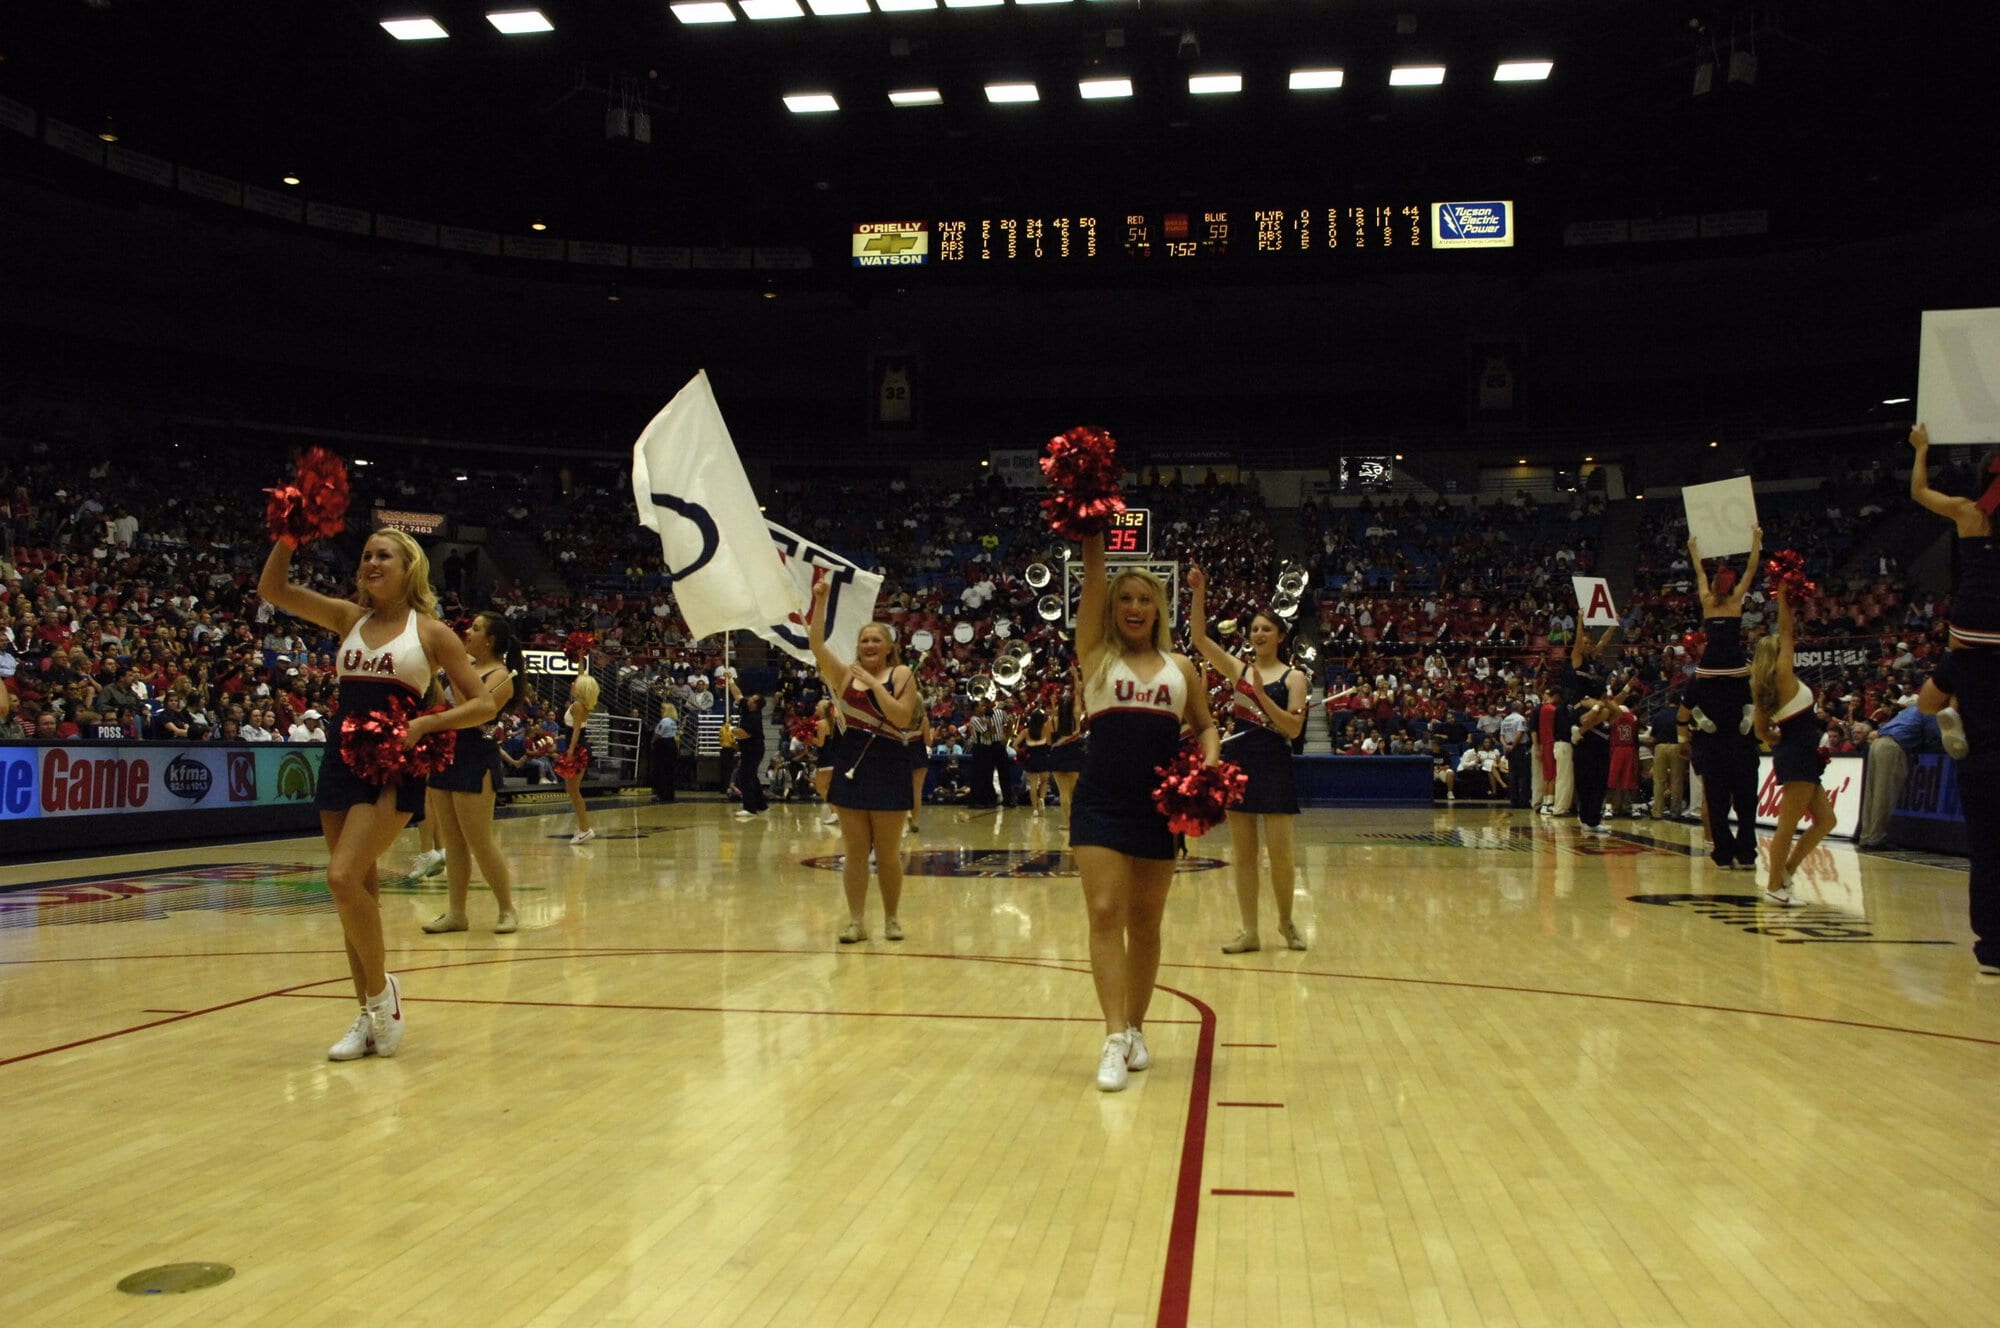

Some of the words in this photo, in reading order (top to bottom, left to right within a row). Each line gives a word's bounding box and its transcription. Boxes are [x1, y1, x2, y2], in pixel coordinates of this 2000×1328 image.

[1204, 213, 1228, 222] BLUE
[1255, 211, 1284, 221] PLYR
[1301, 210, 1310, 220] 0
[1328, 209, 1337, 219] 2
[1349, 207, 1365, 217] 12
[1376, 207, 1392, 217] 14
[1402, 205, 1419, 216] 44
[1455, 206, 1492, 217] Tucson
[938, 221, 966, 232] PLYR
[983, 220, 991, 230] 5
[1001, 219, 1017, 229] 20
[1027, 219, 1043, 229] 34
[1053, 218, 1070, 228] 42
[1080, 217, 1096, 227] 50
[1127, 215, 1144, 225] RED
[1260, 221, 1281, 231] PTS
[1295, 220, 1310, 230] 17
[1459, 215, 1499, 225] Electric
[859, 222, 922, 233] O'RIELLY
[942, 231, 963, 241] PTS
[1088, 227, 1096, 237] 4
[1128, 227, 1147, 242] 54
[1209, 224, 1228, 239] 59
[1463, 224, 1500, 234] Power
[1259, 231, 1282, 241] RBS
[1328, 229, 1337, 239] 0
[941, 241, 964, 251] RBS
[1166, 242, 1198, 257] 7:52
[1259, 240, 1282, 251] FLS
[1301, 240, 1310, 250] 5
[1328, 239, 1337, 249] 0
[1034, 248, 1043, 258] 0
[859, 255, 922, 266] WATSON
[886, 386, 905, 400] 32
[1113, 513, 1144, 526] 7:52
[1108, 530, 1137, 551] 35
[1586, 583, 1616, 620] A
[344, 649, 362, 671] U
[362, 656, 378, 671] of
[377, 651, 396, 674] A
[1793, 651, 1833, 667] USCLE
[1115, 680, 1134, 702] U
[1135, 690, 1153, 703] of
[1154, 684, 1172, 706] A
[98, 726, 125, 739] POSS.
[1617, 724, 1632, 741] 13
[169, 764, 208, 781] kfma
[0, 759, 33, 814] e
[41, 748, 150, 813] Game
